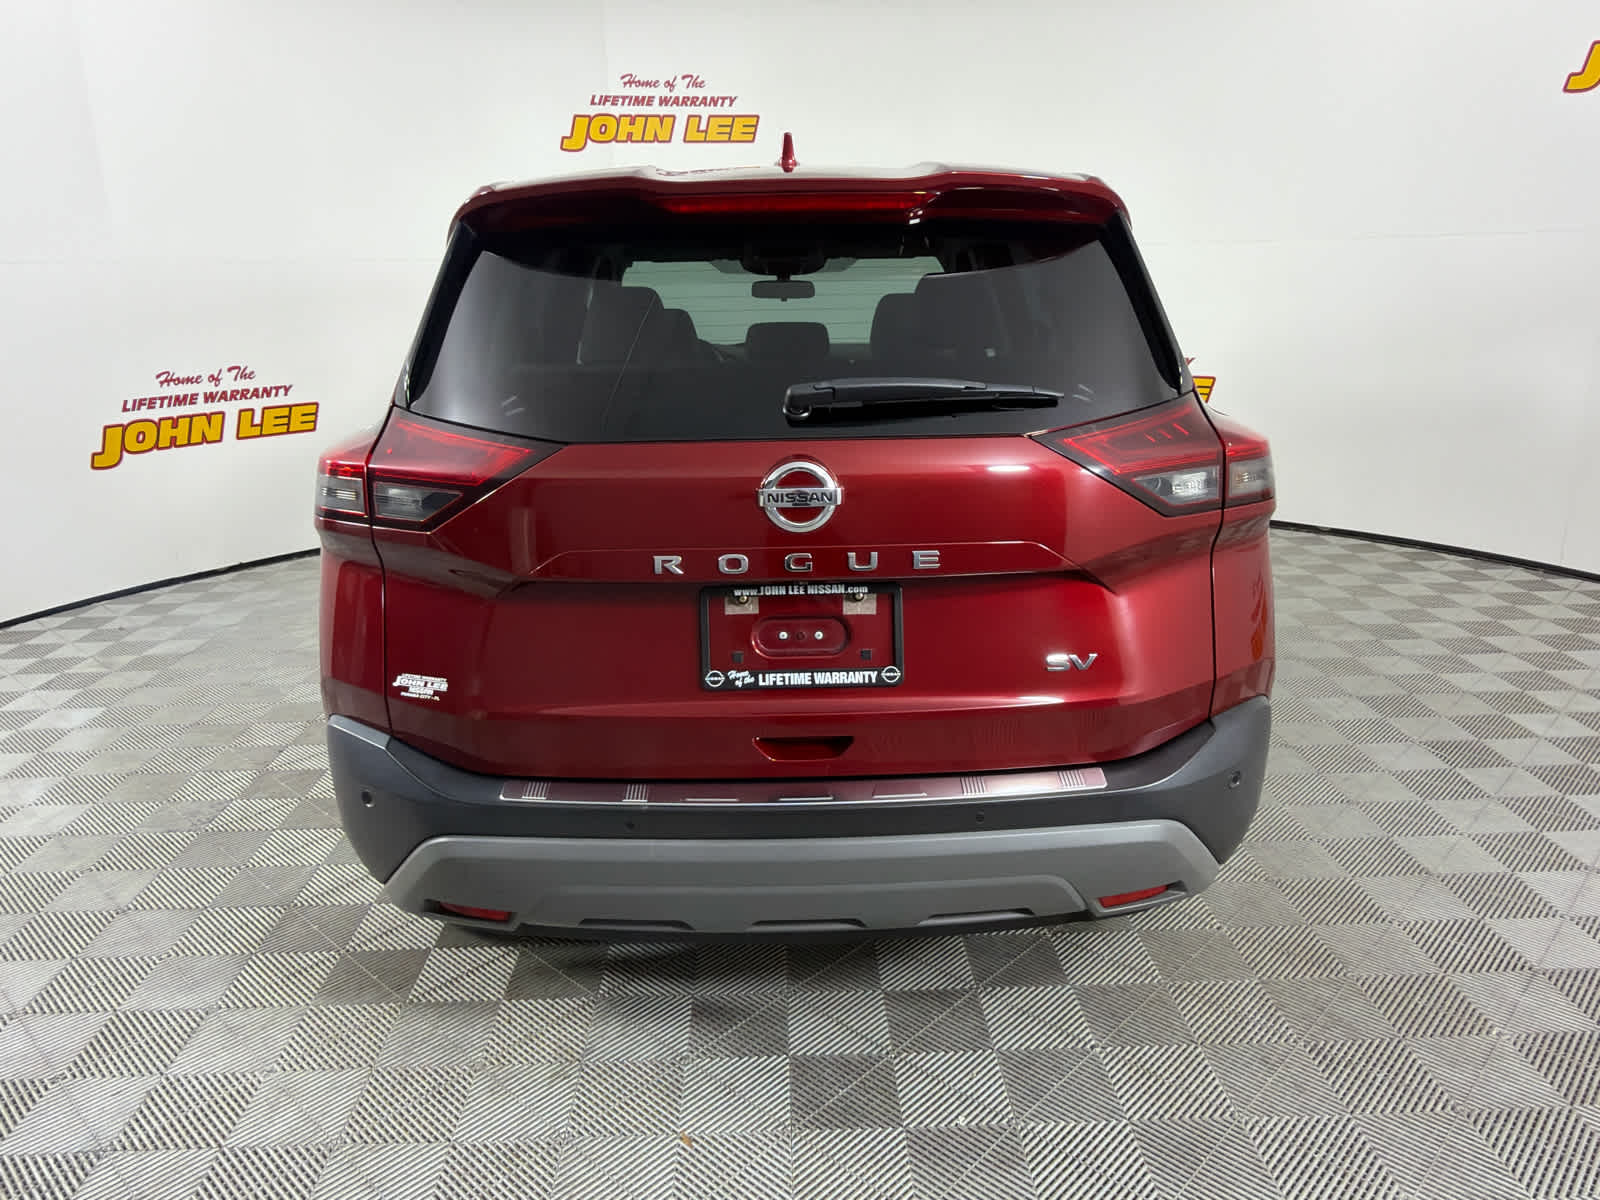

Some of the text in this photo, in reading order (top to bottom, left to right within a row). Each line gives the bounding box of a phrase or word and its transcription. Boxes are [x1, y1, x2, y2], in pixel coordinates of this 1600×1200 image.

[620, 73, 706, 93] Home of The
[590, 94, 738, 107] LIFETIME WARRANTY
[560, 113, 760, 152] JOHN LEE
[156, 366, 256, 388] Home of The
[121, 385, 293, 413] LIFETIME WARRANTY
[91, 402, 319, 470] JOHN LEE
[767, 491, 833, 503] NISSAN
[653, 550, 940, 575] ROGUE
[788, 585, 805, 595] LEE
[1046, 653, 1098, 671] SV
[758, 671, 878, 686] LIFETIME WARRANTY
